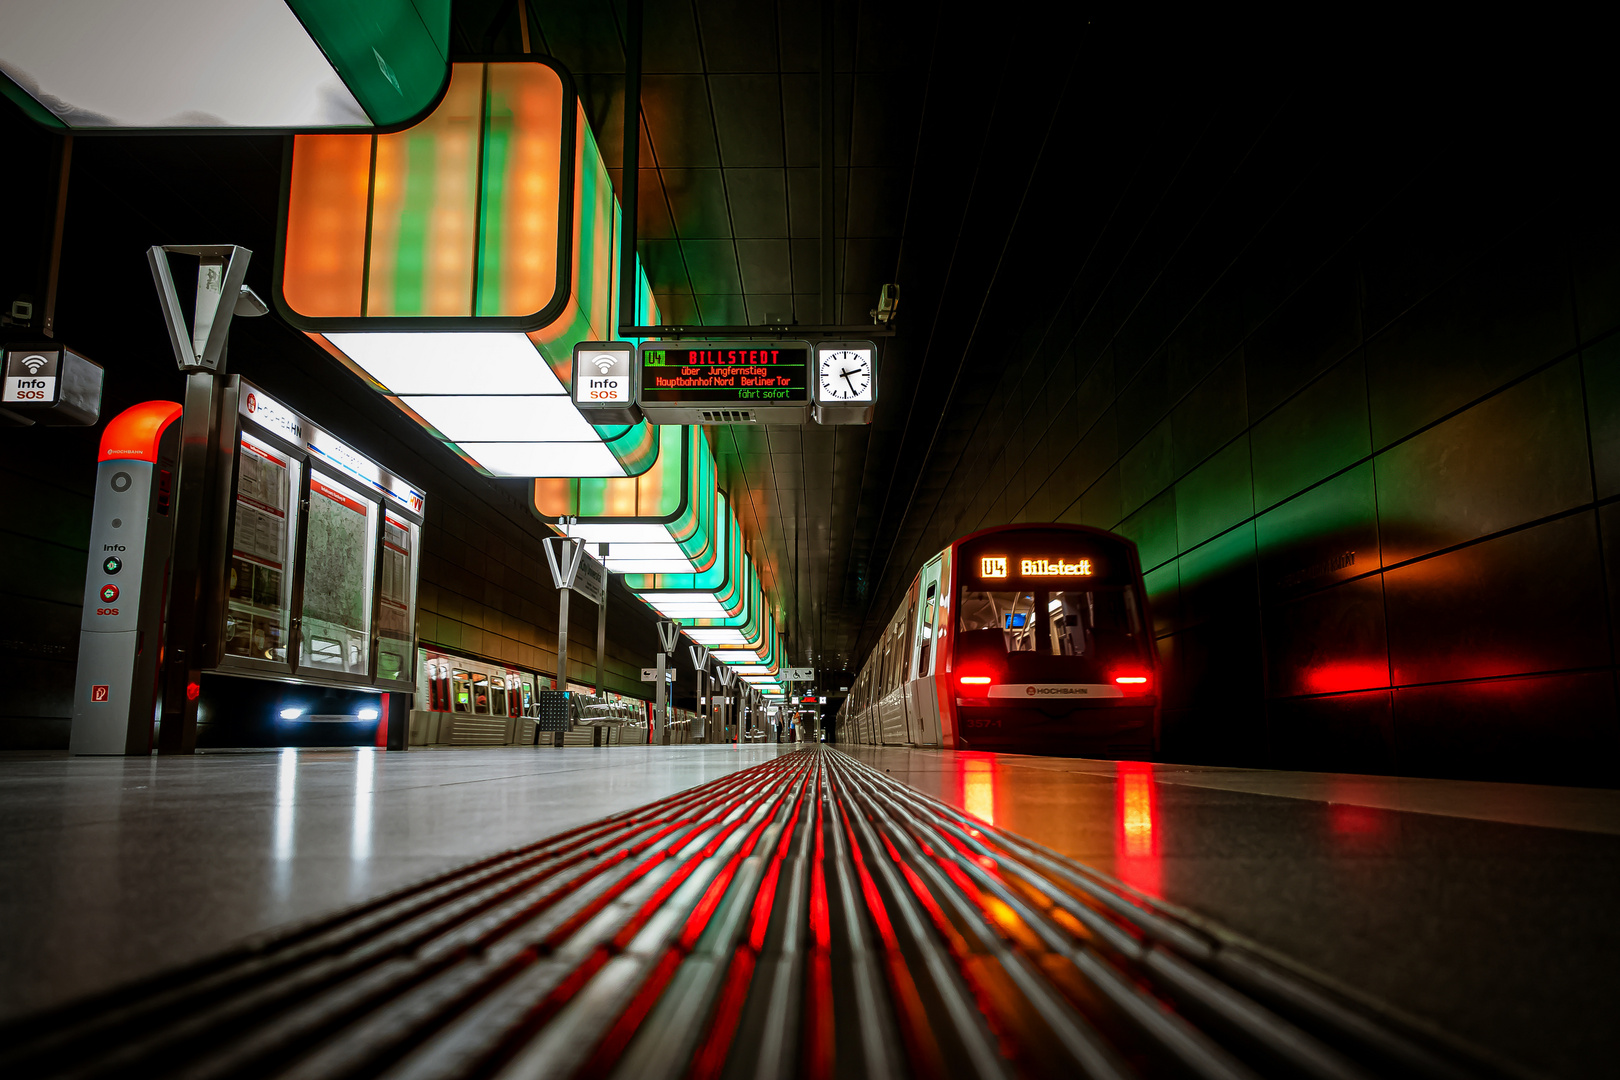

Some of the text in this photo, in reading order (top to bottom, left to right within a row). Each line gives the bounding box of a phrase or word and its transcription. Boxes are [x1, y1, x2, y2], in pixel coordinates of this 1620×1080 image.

[648, 350, 779, 365] U4 BILLSTEDT
[681, 366, 767, 378] über Jungfernstieg
[17, 379, 46, 389] Info
[590, 379, 618, 388] Info
[656, 376, 791, 388] Hauptbahnhof Nord Berliner Tor
[16, 390, 45, 399] SOS
[590, 391, 618, 399] SOS
[738, 389, 790, 399] fährt sofort
[257, 402, 302, 438] HOCBAHN
[103, 544, 126, 552] Info
[984, 559, 1092, 576] U4 Billstedt
[96, 607, 119, 616] SOS
[967, 719, 1002, 728] 357-1
